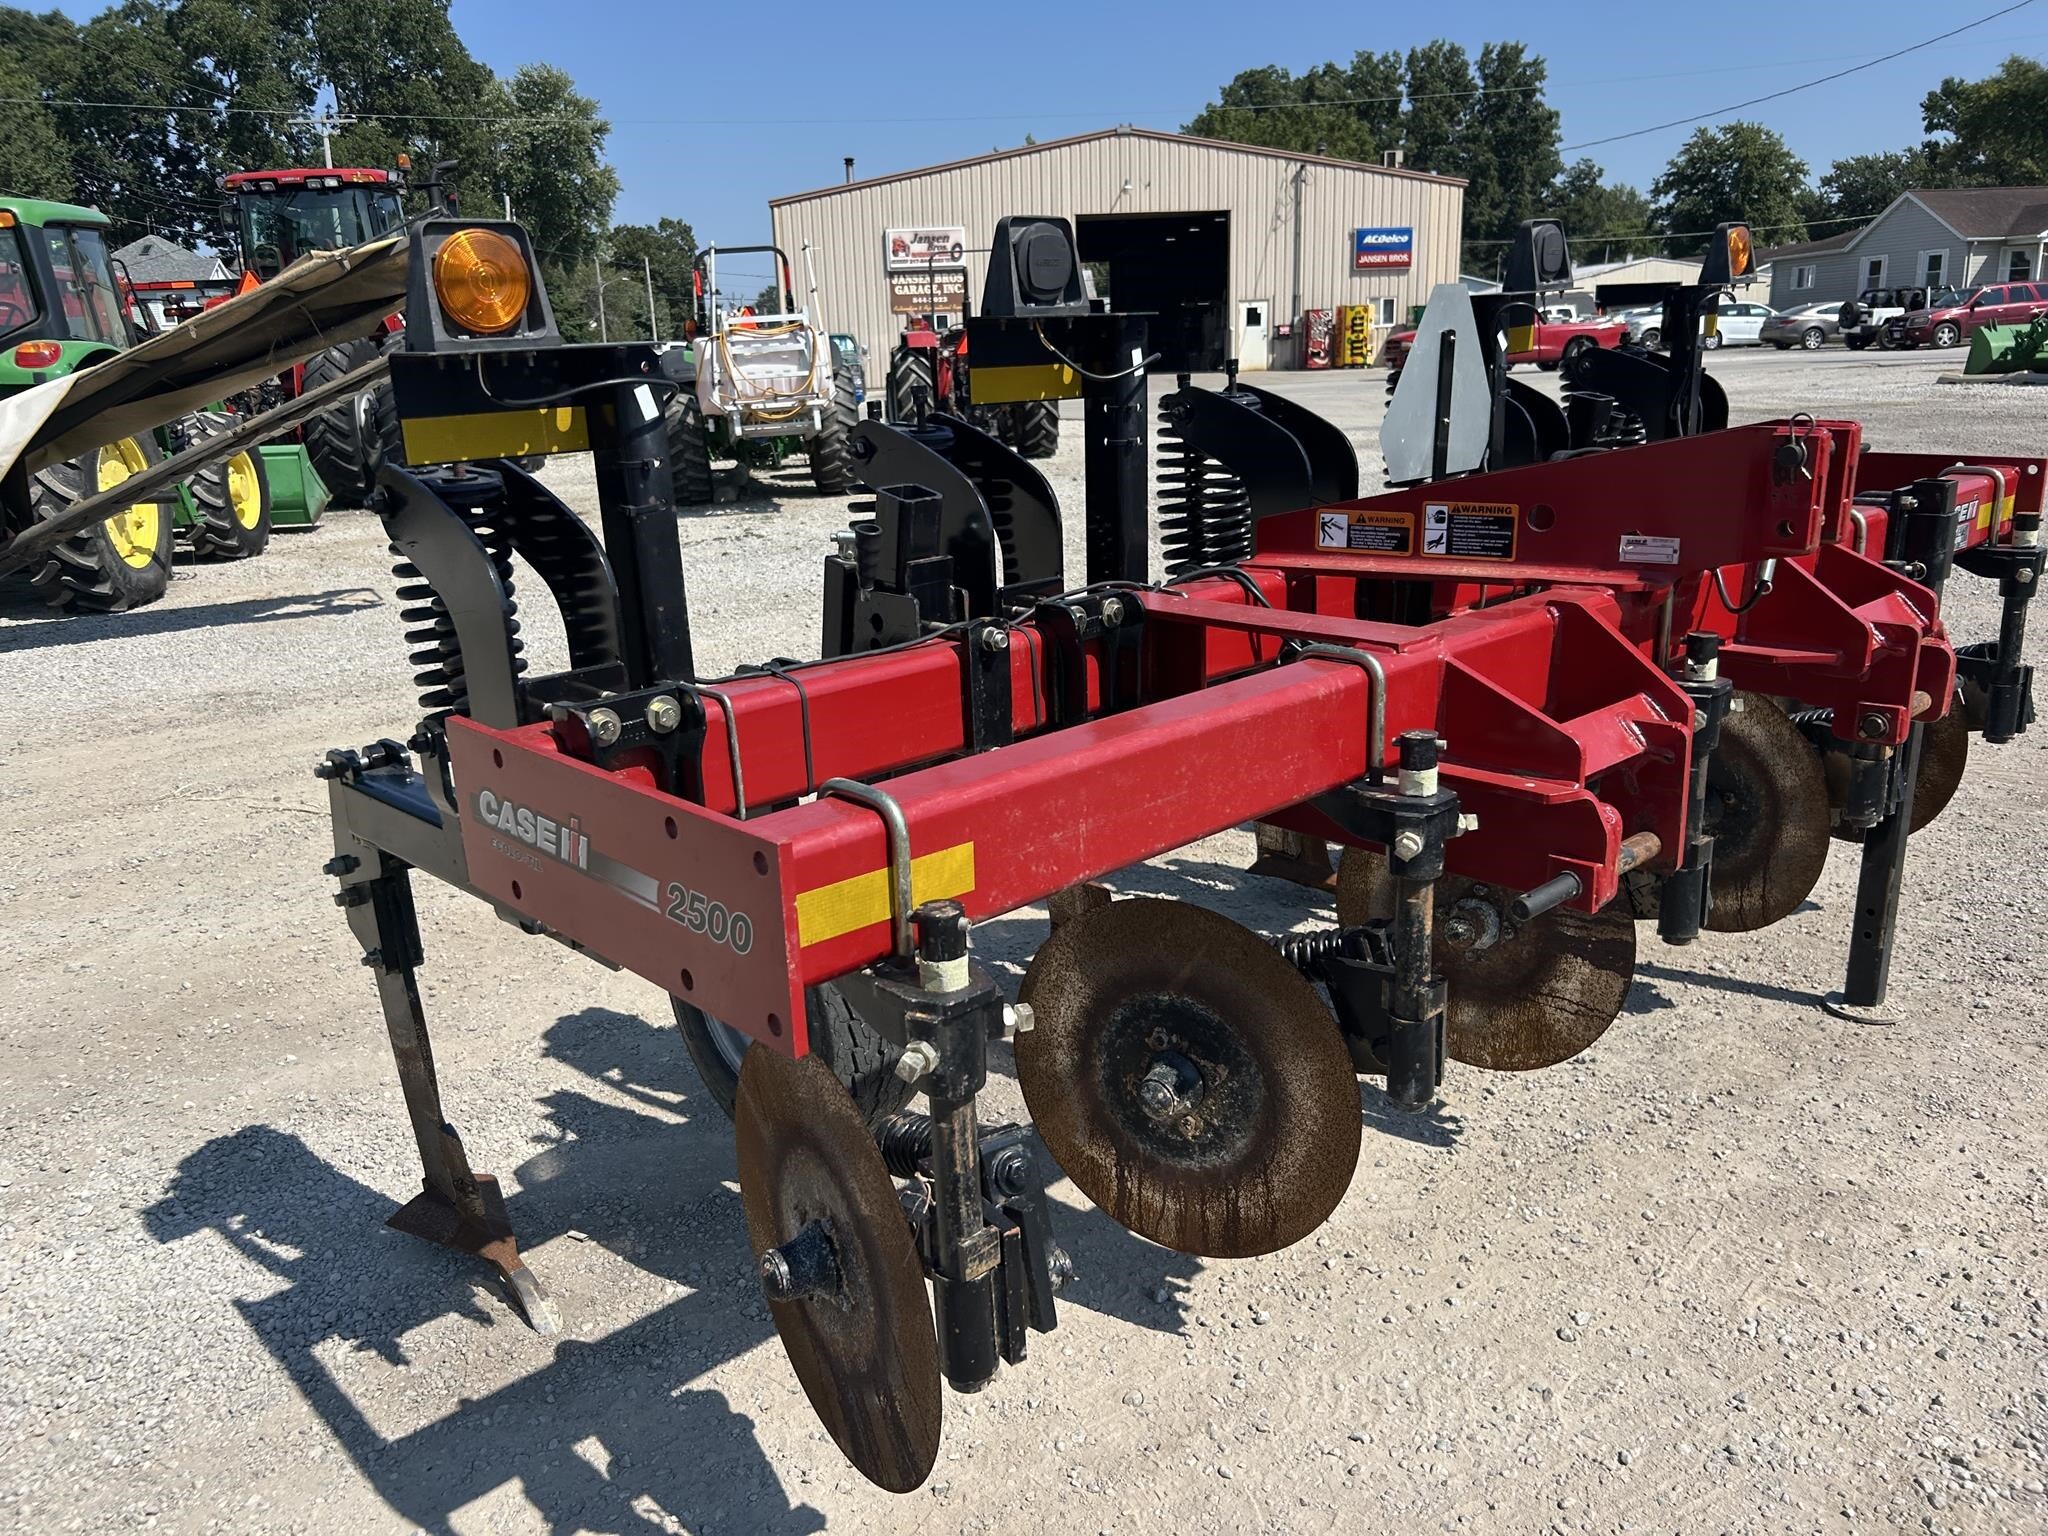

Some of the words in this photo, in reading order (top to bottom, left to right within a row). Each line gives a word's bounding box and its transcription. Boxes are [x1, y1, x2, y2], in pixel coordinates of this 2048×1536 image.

[910, 233, 950, 245] Jansen
[1363, 234, 1409, 244] ACDelco
[1359, 254, 1388, 263] JANSEN
[943, 284, 965, 294] INC.
[1460, 505, 1513, 515] WARNING
[1367, 515, 1405, 524] WARNING
[480, 790, 557, 855] CASE
[666, 882, 753, 955] 2500
